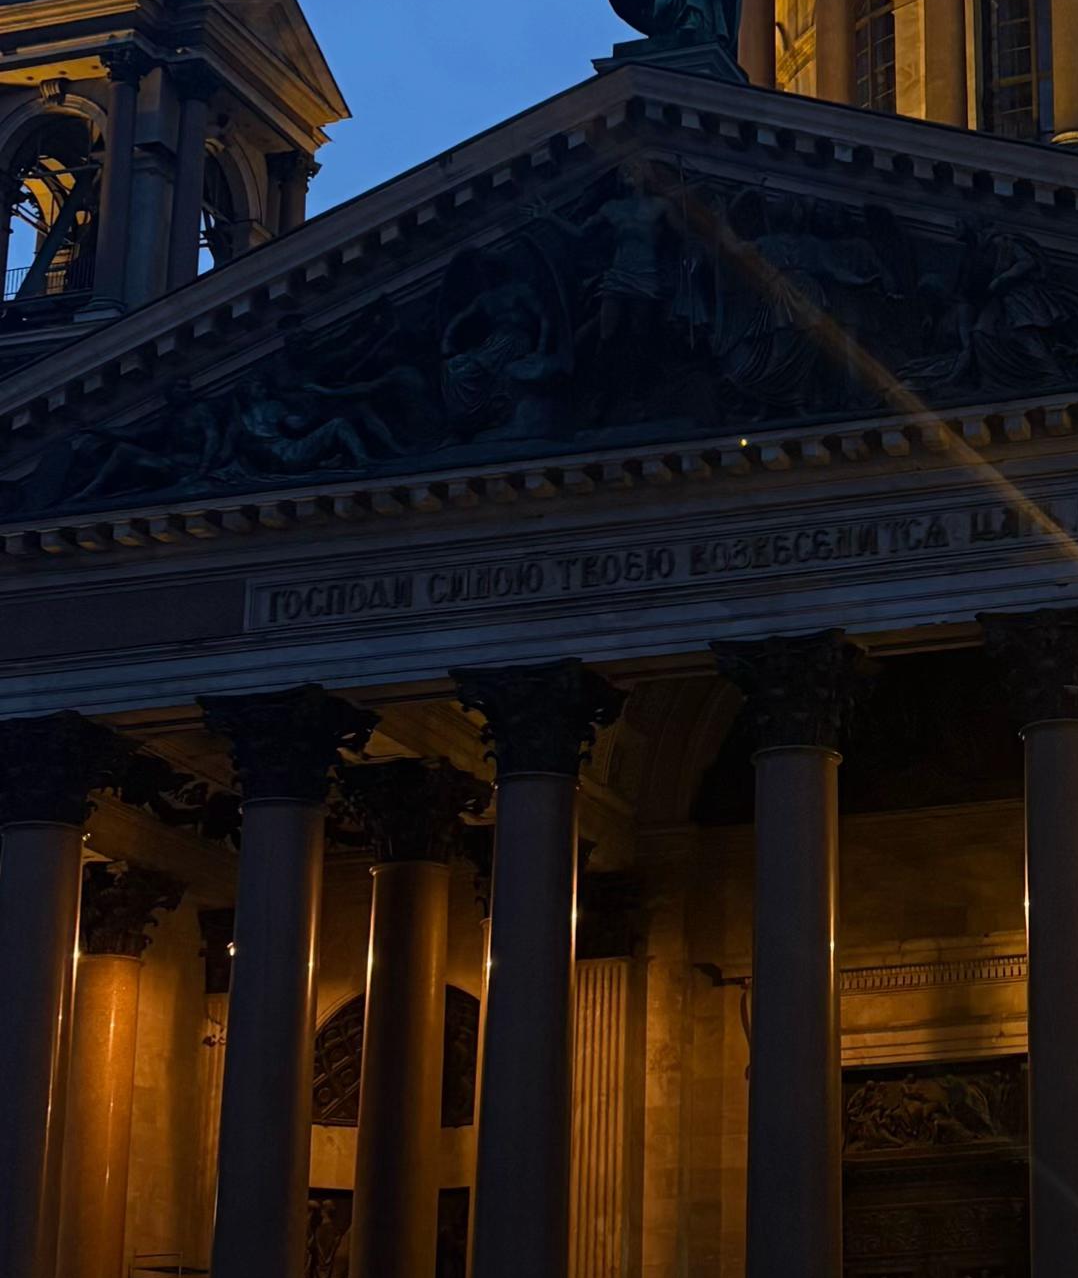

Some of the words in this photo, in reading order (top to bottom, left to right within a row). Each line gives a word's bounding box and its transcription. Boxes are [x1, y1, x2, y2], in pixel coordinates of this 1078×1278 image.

[269, 574, 413, 623] ГОСПОДИ
[427, 562, 544, 604] СИЛОЮ
[556, 548, 676, 591] ТВОЕЮ
